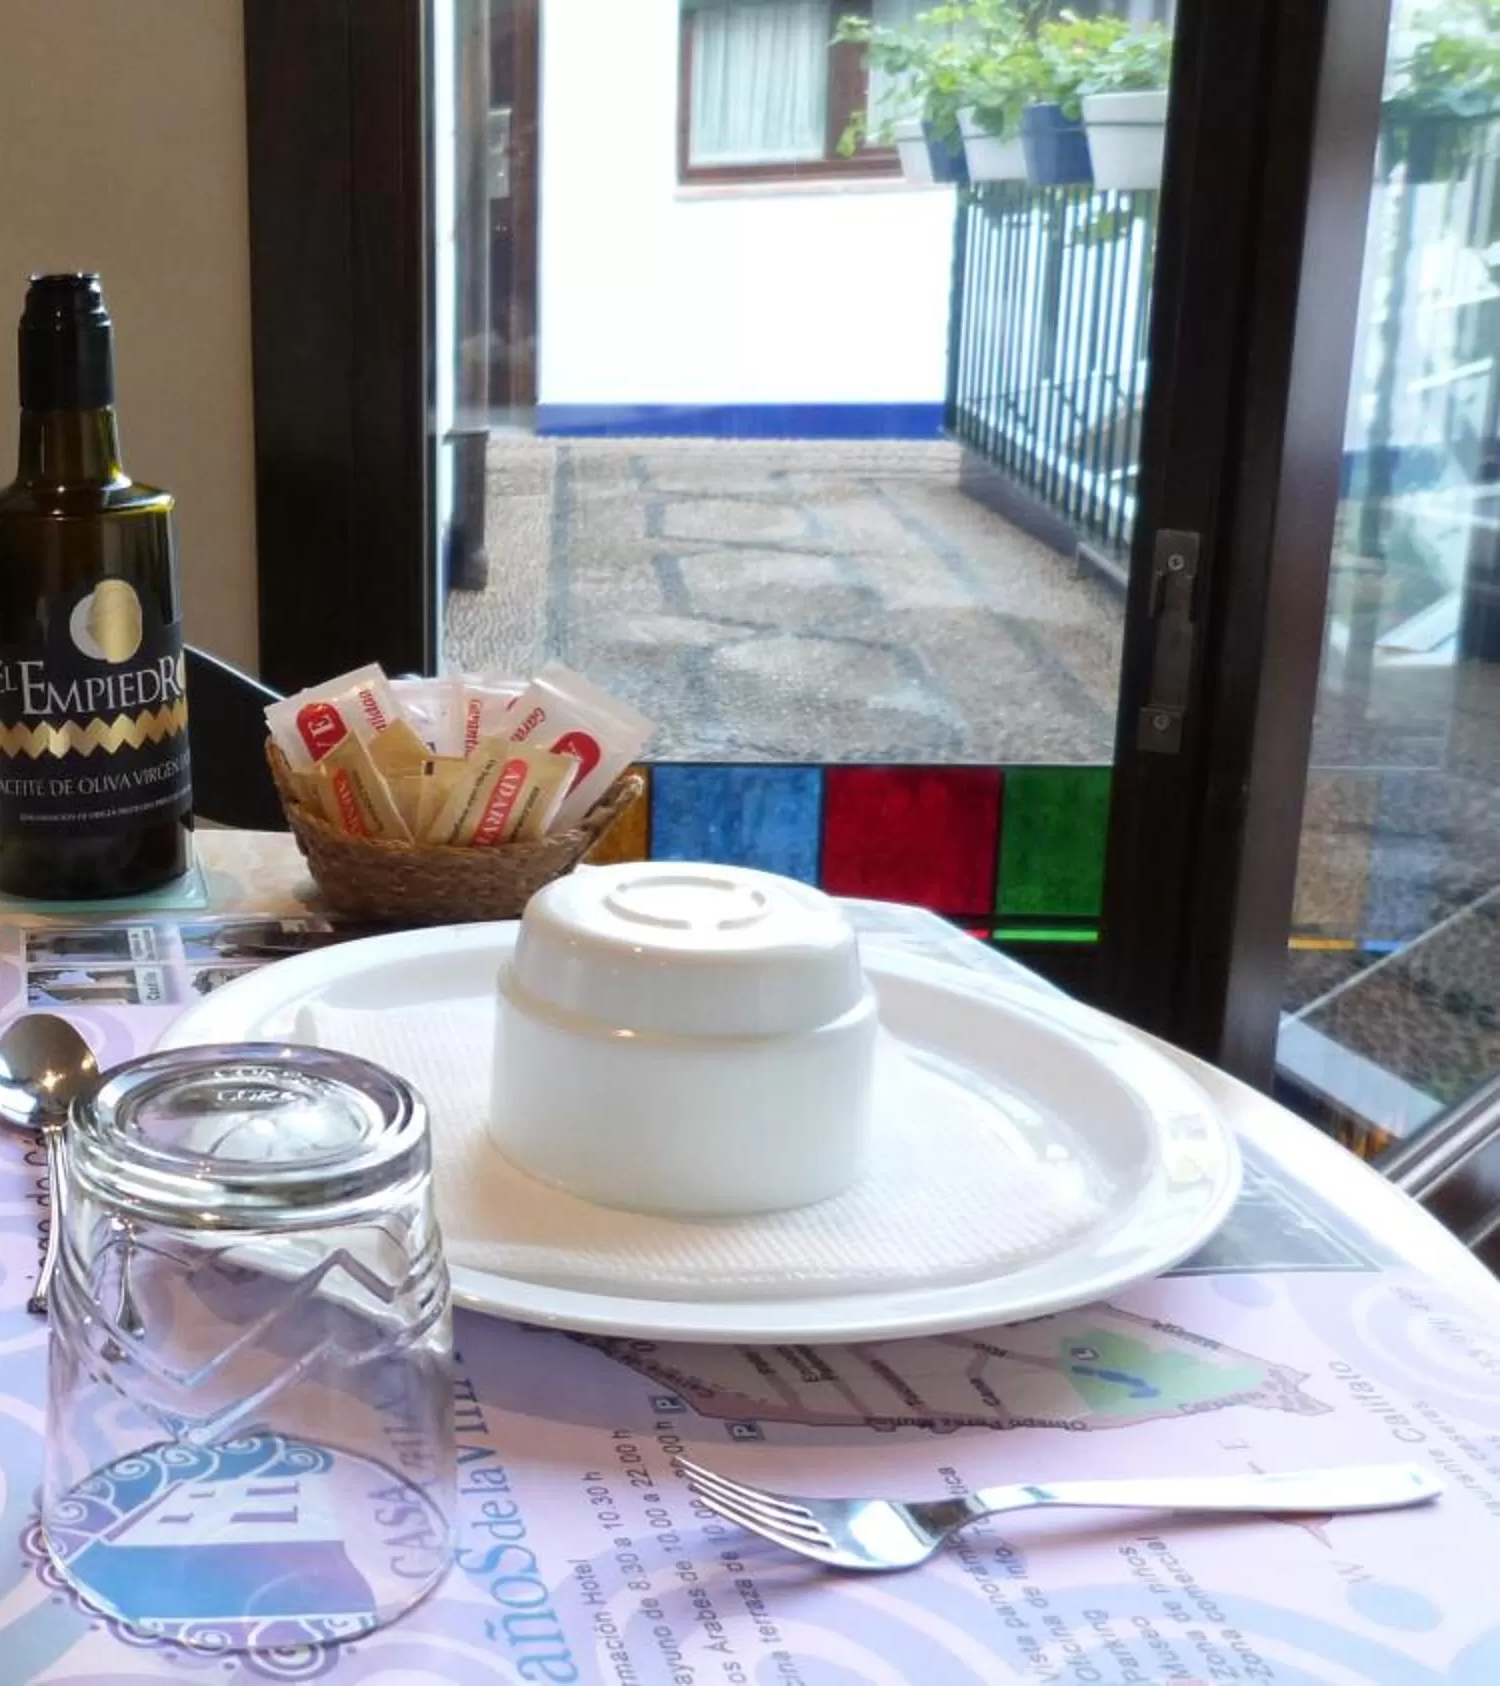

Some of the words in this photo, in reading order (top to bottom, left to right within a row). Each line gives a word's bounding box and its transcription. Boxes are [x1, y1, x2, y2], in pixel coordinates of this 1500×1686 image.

[51, 779, 75, 797] DE
[78, 773, 131, 794] OLIVA
[133, 760, 180, 786] VIRGEN
[460, 1465, 512, 1494] la
[615, 1443, 654, 1488] 22.00
[470, 1499, 527, 1541] de
[586, 1485, 625, 1530] 10.30
[645, 1507, 684, 1553] 10.00
[367, 1484, 439, 1579] CASA
[566, 1558, 608, 1605] Hotel
[616, 1553, 651, 1591] 8.30
[675, 1559, 699, 1582] de
[720, 1550, 745, 1573] de
[947, 1532, 1030, 1630] panorámic
[1136, 1535, 1227, 1623] comercial
[639, 1597, 664, 1620] de
[1022, 1585, 1049, 1609] de
[1161, 1600, 1192, 1624] de
[1016, 1635, 1061, 1684] Vista
[1041, 1615, 1103, 1683] Oficina
[1081, 1609, 1149, 1682] Parking
[1131, 1615, 1194, 1680] Museo
[1184, 1629, 1240, 1680] Zona
[1219, 1628, 1276, 1680] Zona
